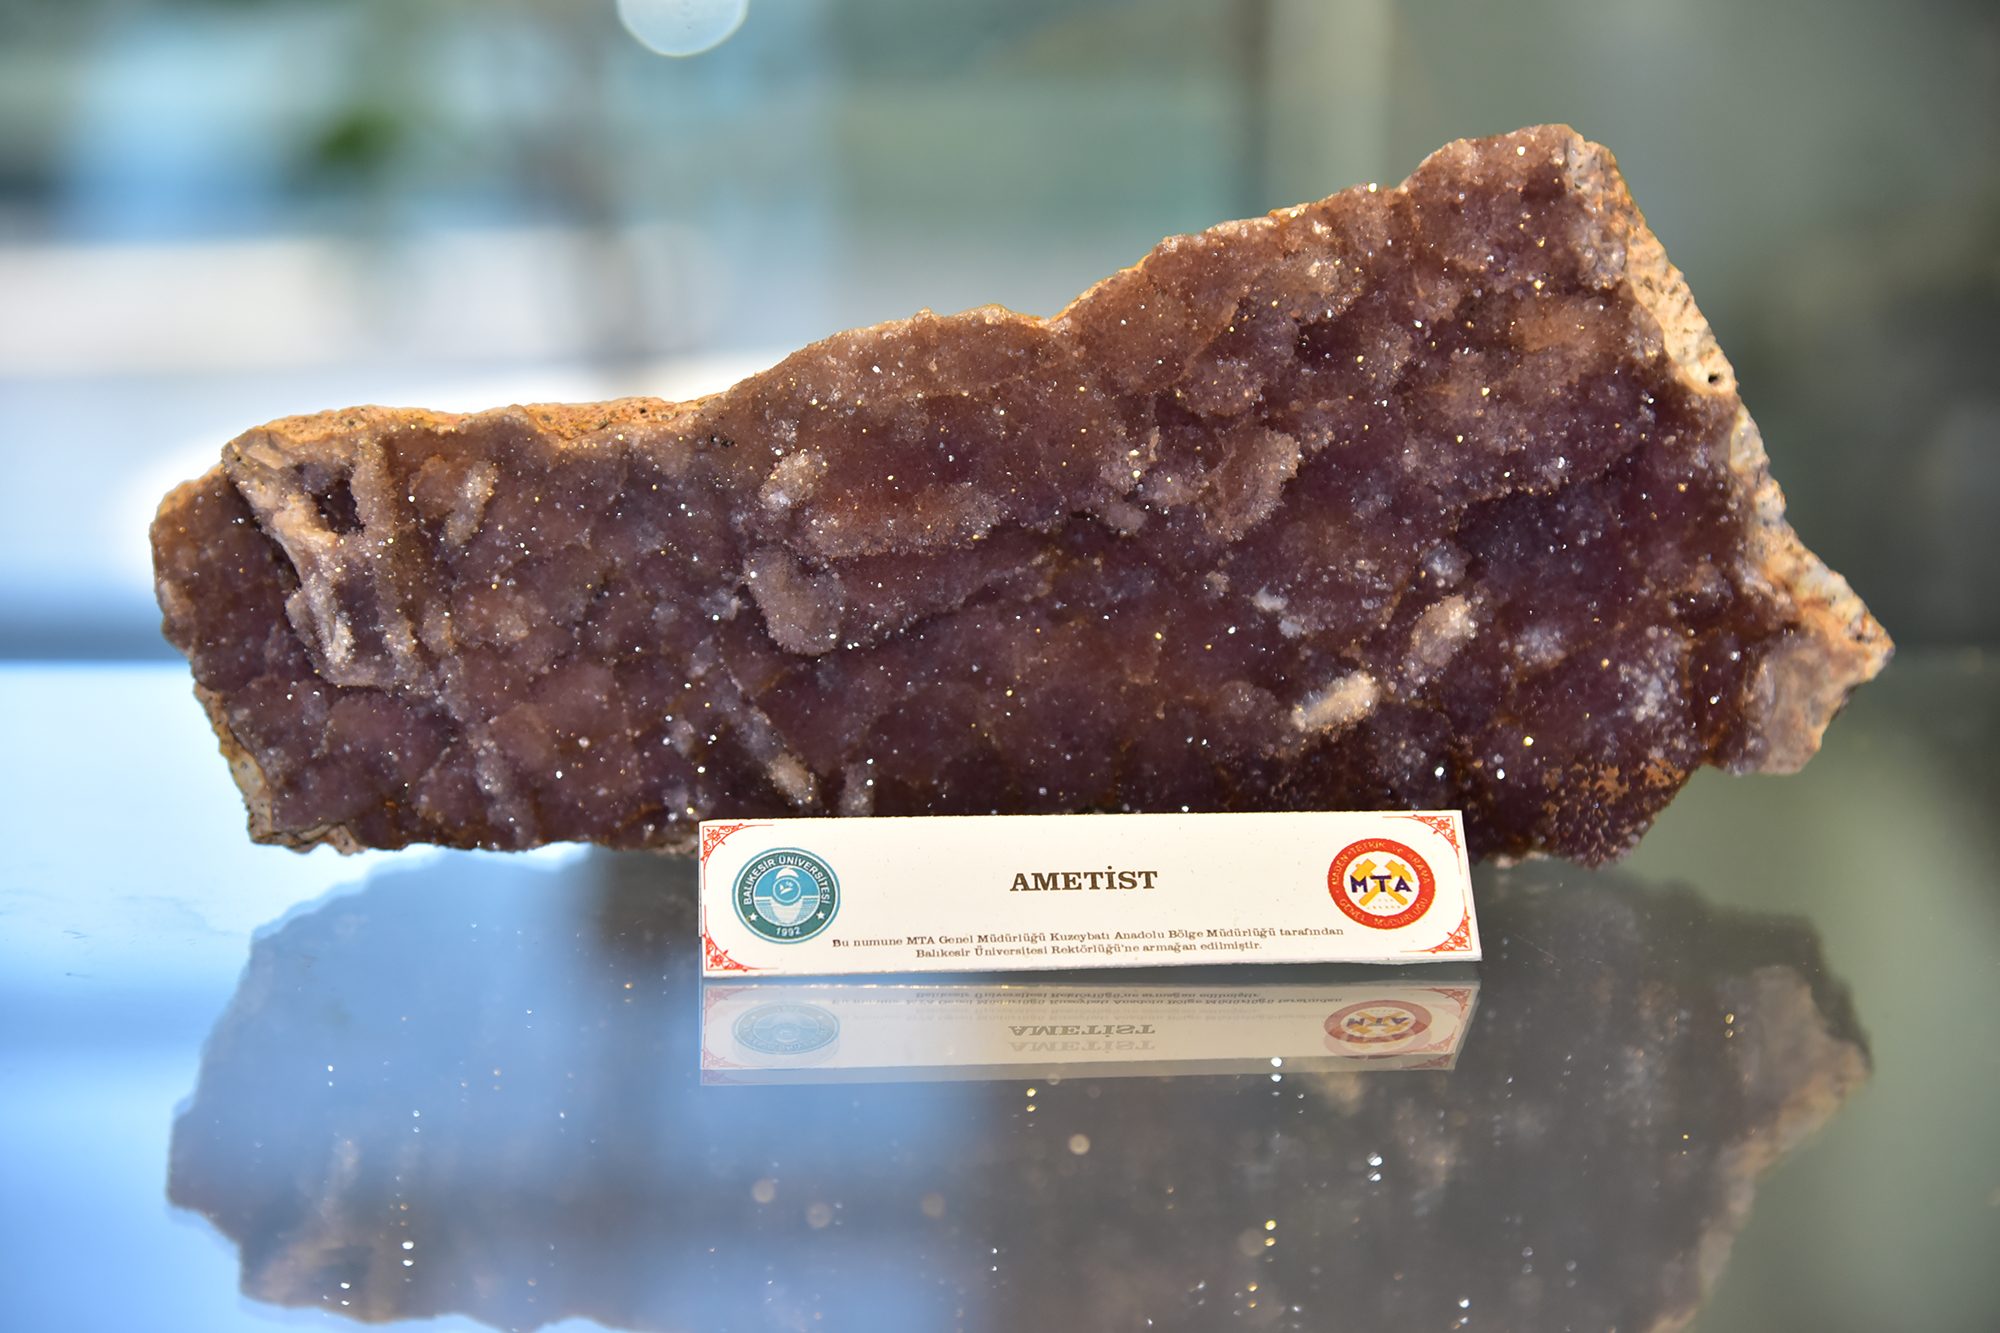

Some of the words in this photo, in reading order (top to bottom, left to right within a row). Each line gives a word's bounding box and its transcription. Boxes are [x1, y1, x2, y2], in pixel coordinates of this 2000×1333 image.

[1009, 865, 1159, 892] AMETİST
[1350, 874, 1412, 893] MTA
[776, 926, 801, 937] 1992
[831, 938, 850, 948] Bu
[853, 938, 903, 947] numune
[906, 935, 936, 946] MTA
[938, 934, 974, 945] Genel
[976, 932, 1046, 943] Müdürlüğü
[1049, 931, 1110, 944] Kuzeybatı
[1113, 930, 1165, 940] Anadolu
[1167, 929, 1204, 941] Bölge
[1205, 927, 1277, 939] Müdürlüğü
[1279, 927, 1344, 937] tarafından
[915, 947, 971, 959] Balıkesir
[973, 945, 1048, 957] Üniversitesi
[1142, 942, 1197, 954] armağan
[1199, 940, 1262, 952] edilmiştir.
